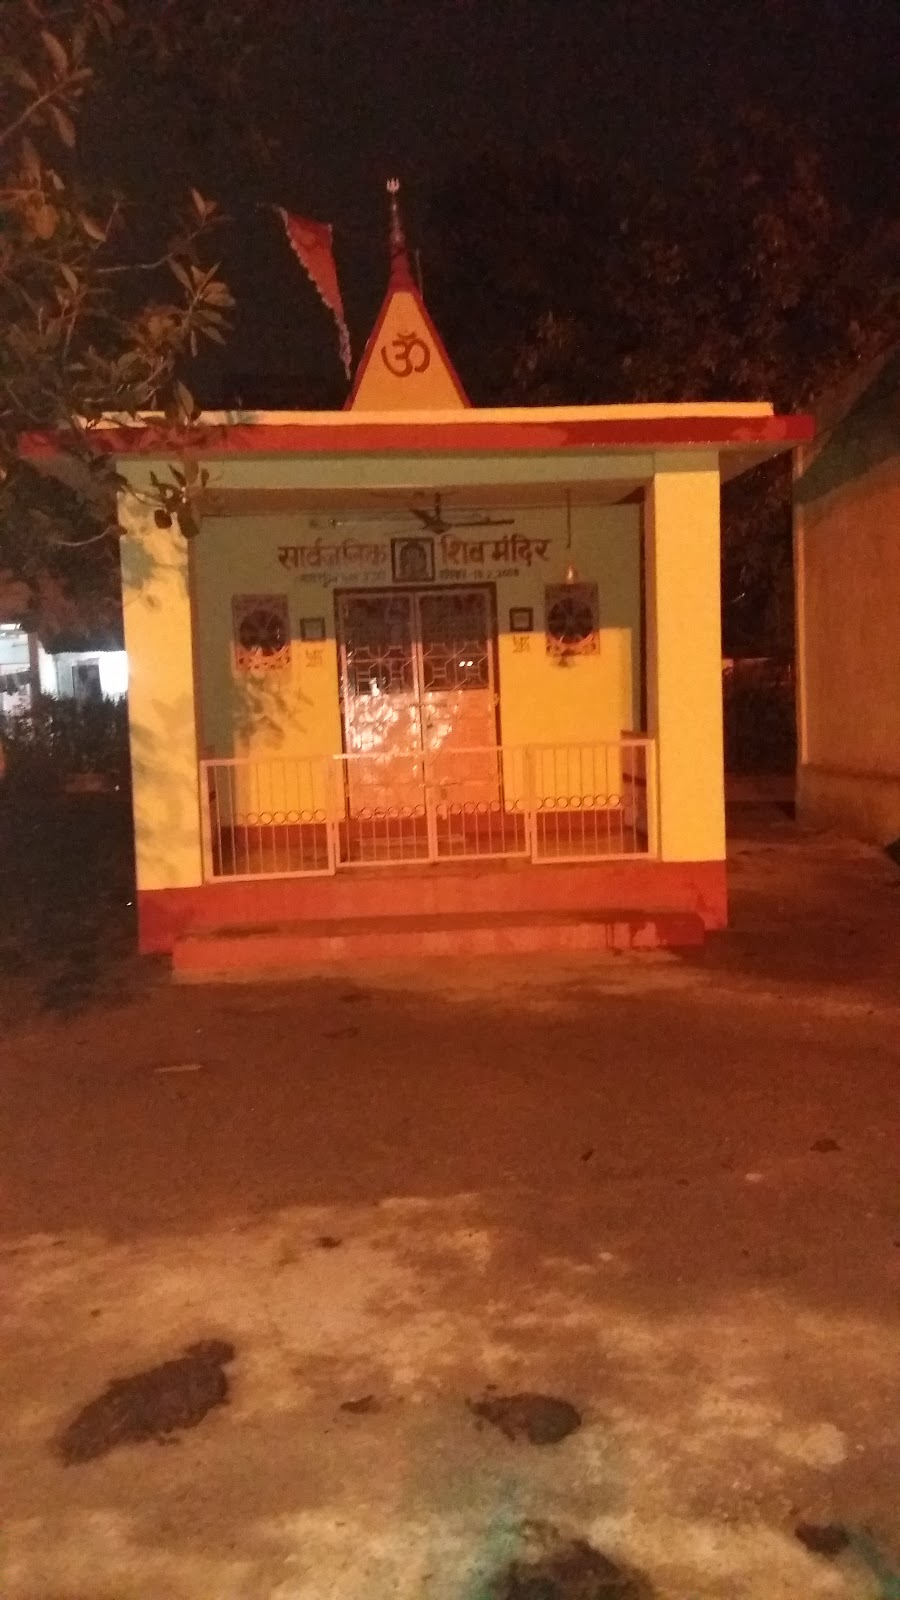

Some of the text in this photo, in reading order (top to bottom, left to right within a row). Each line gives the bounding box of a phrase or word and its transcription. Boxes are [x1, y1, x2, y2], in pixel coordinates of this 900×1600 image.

[278, 533, 552, 570] सार्वजनिक शिव मंदिर
